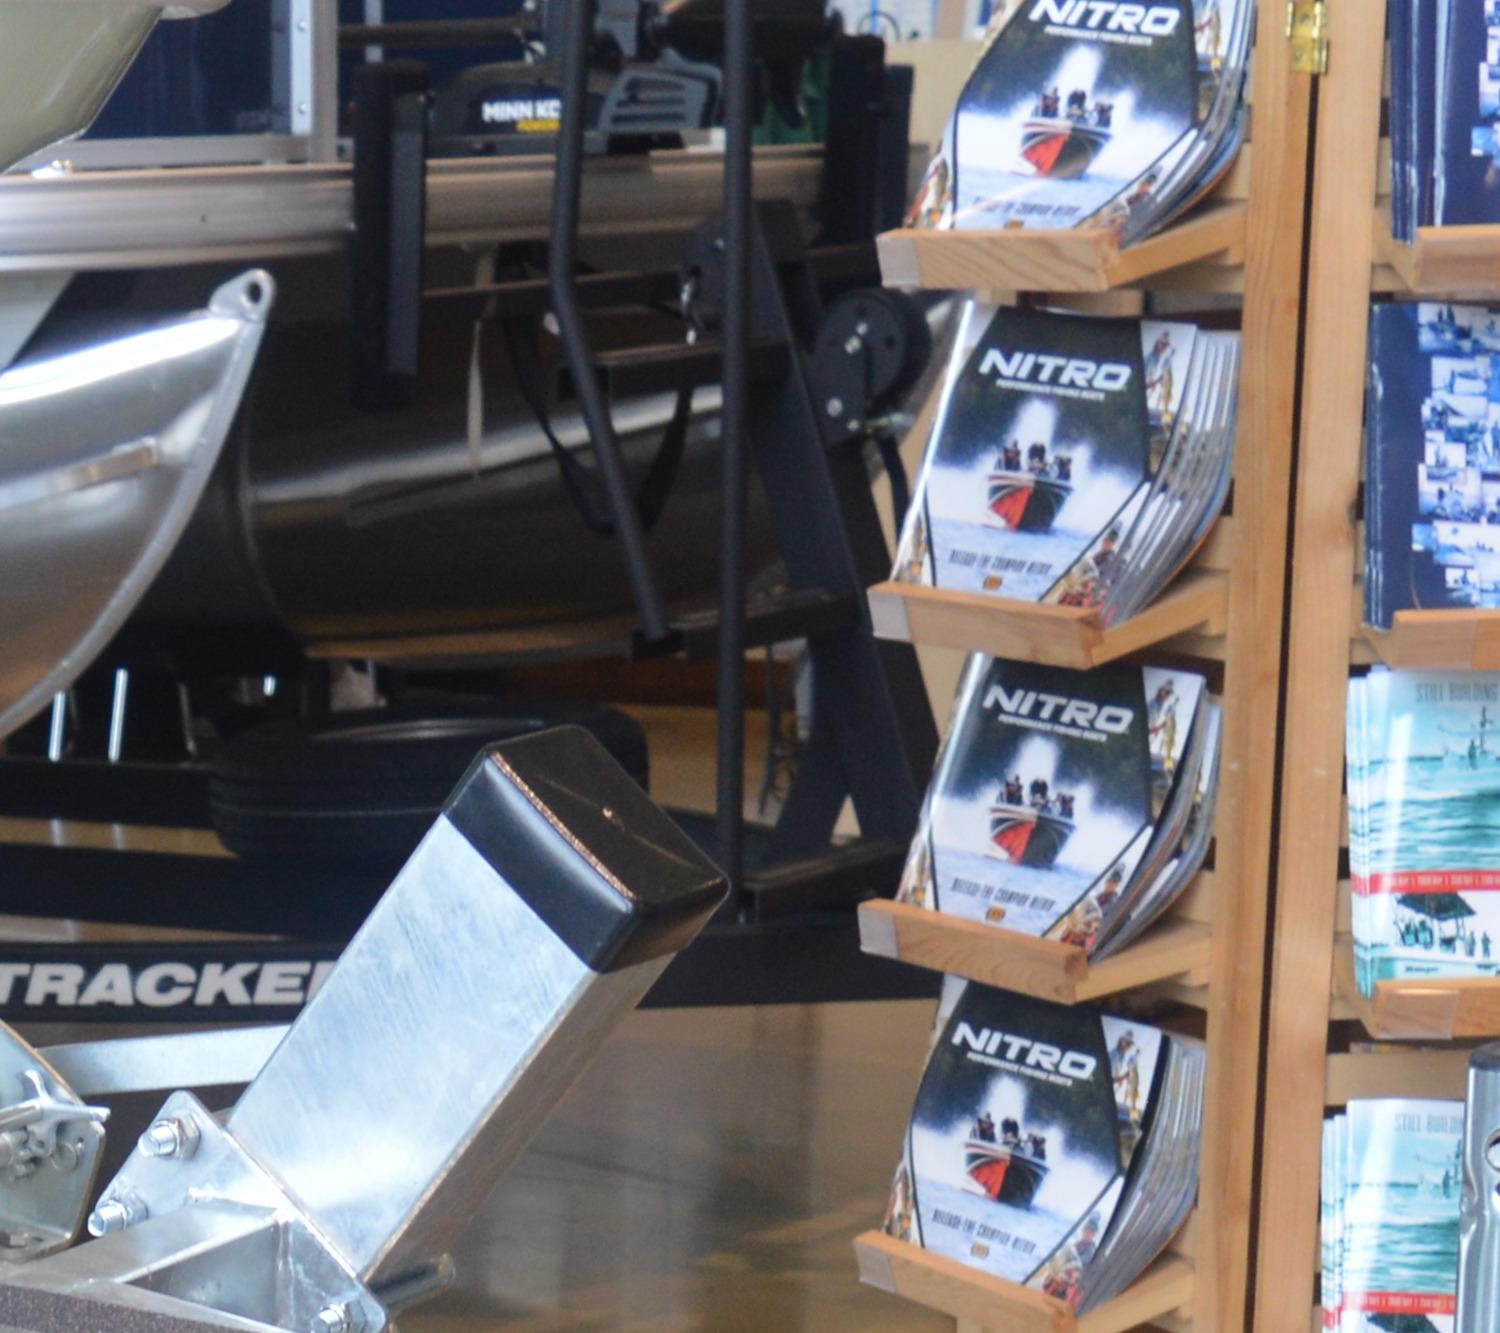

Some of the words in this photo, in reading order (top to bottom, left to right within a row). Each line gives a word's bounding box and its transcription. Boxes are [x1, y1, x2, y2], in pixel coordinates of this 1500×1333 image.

[1028, 0, 1180, 36] NITRO
[482, 100, 533, 122] MINN
[978, 348, 1132, 391] NITRO
[982, 684, 1134, 734] NITRO
[952, 1021, 1097, 1081] NITRO
